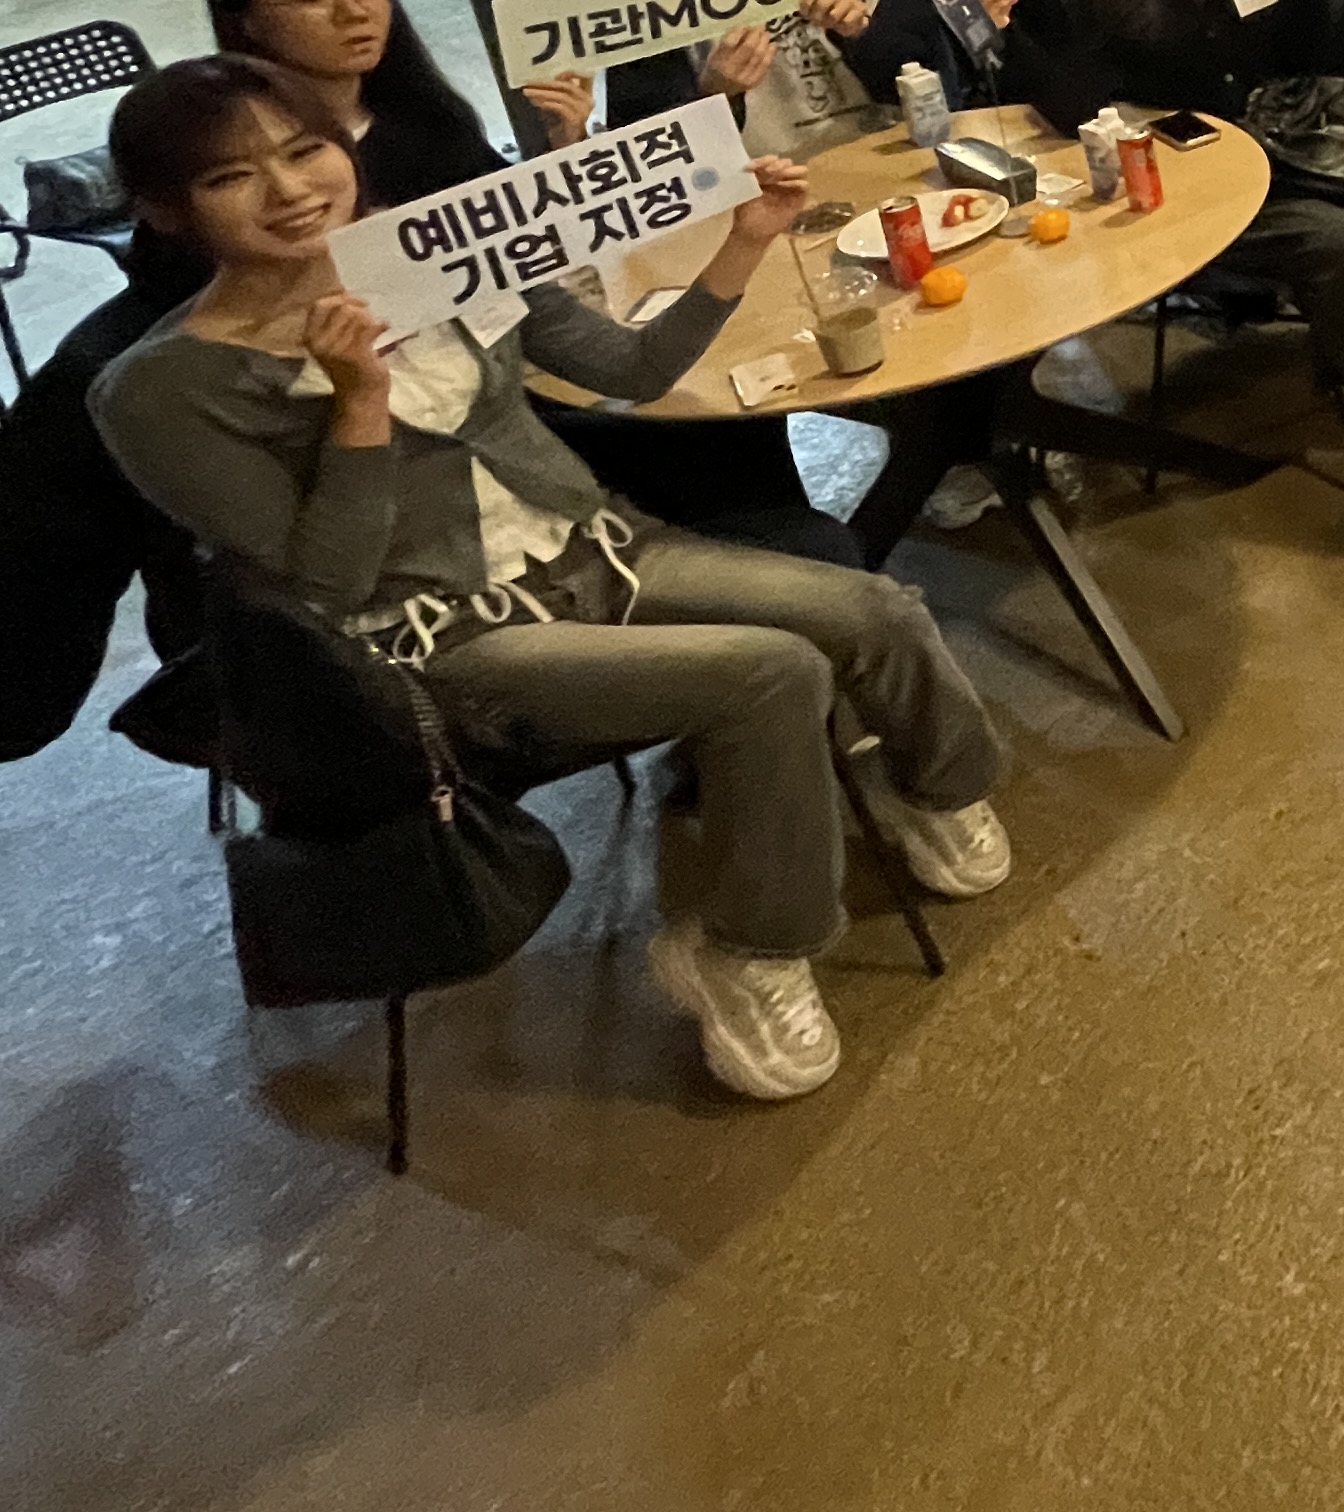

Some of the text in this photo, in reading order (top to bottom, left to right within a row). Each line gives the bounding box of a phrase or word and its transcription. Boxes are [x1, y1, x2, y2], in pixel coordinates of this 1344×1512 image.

[398, 120, 696, 264] 예비사회적
[441, 175, 694, 306] 기업 지정
